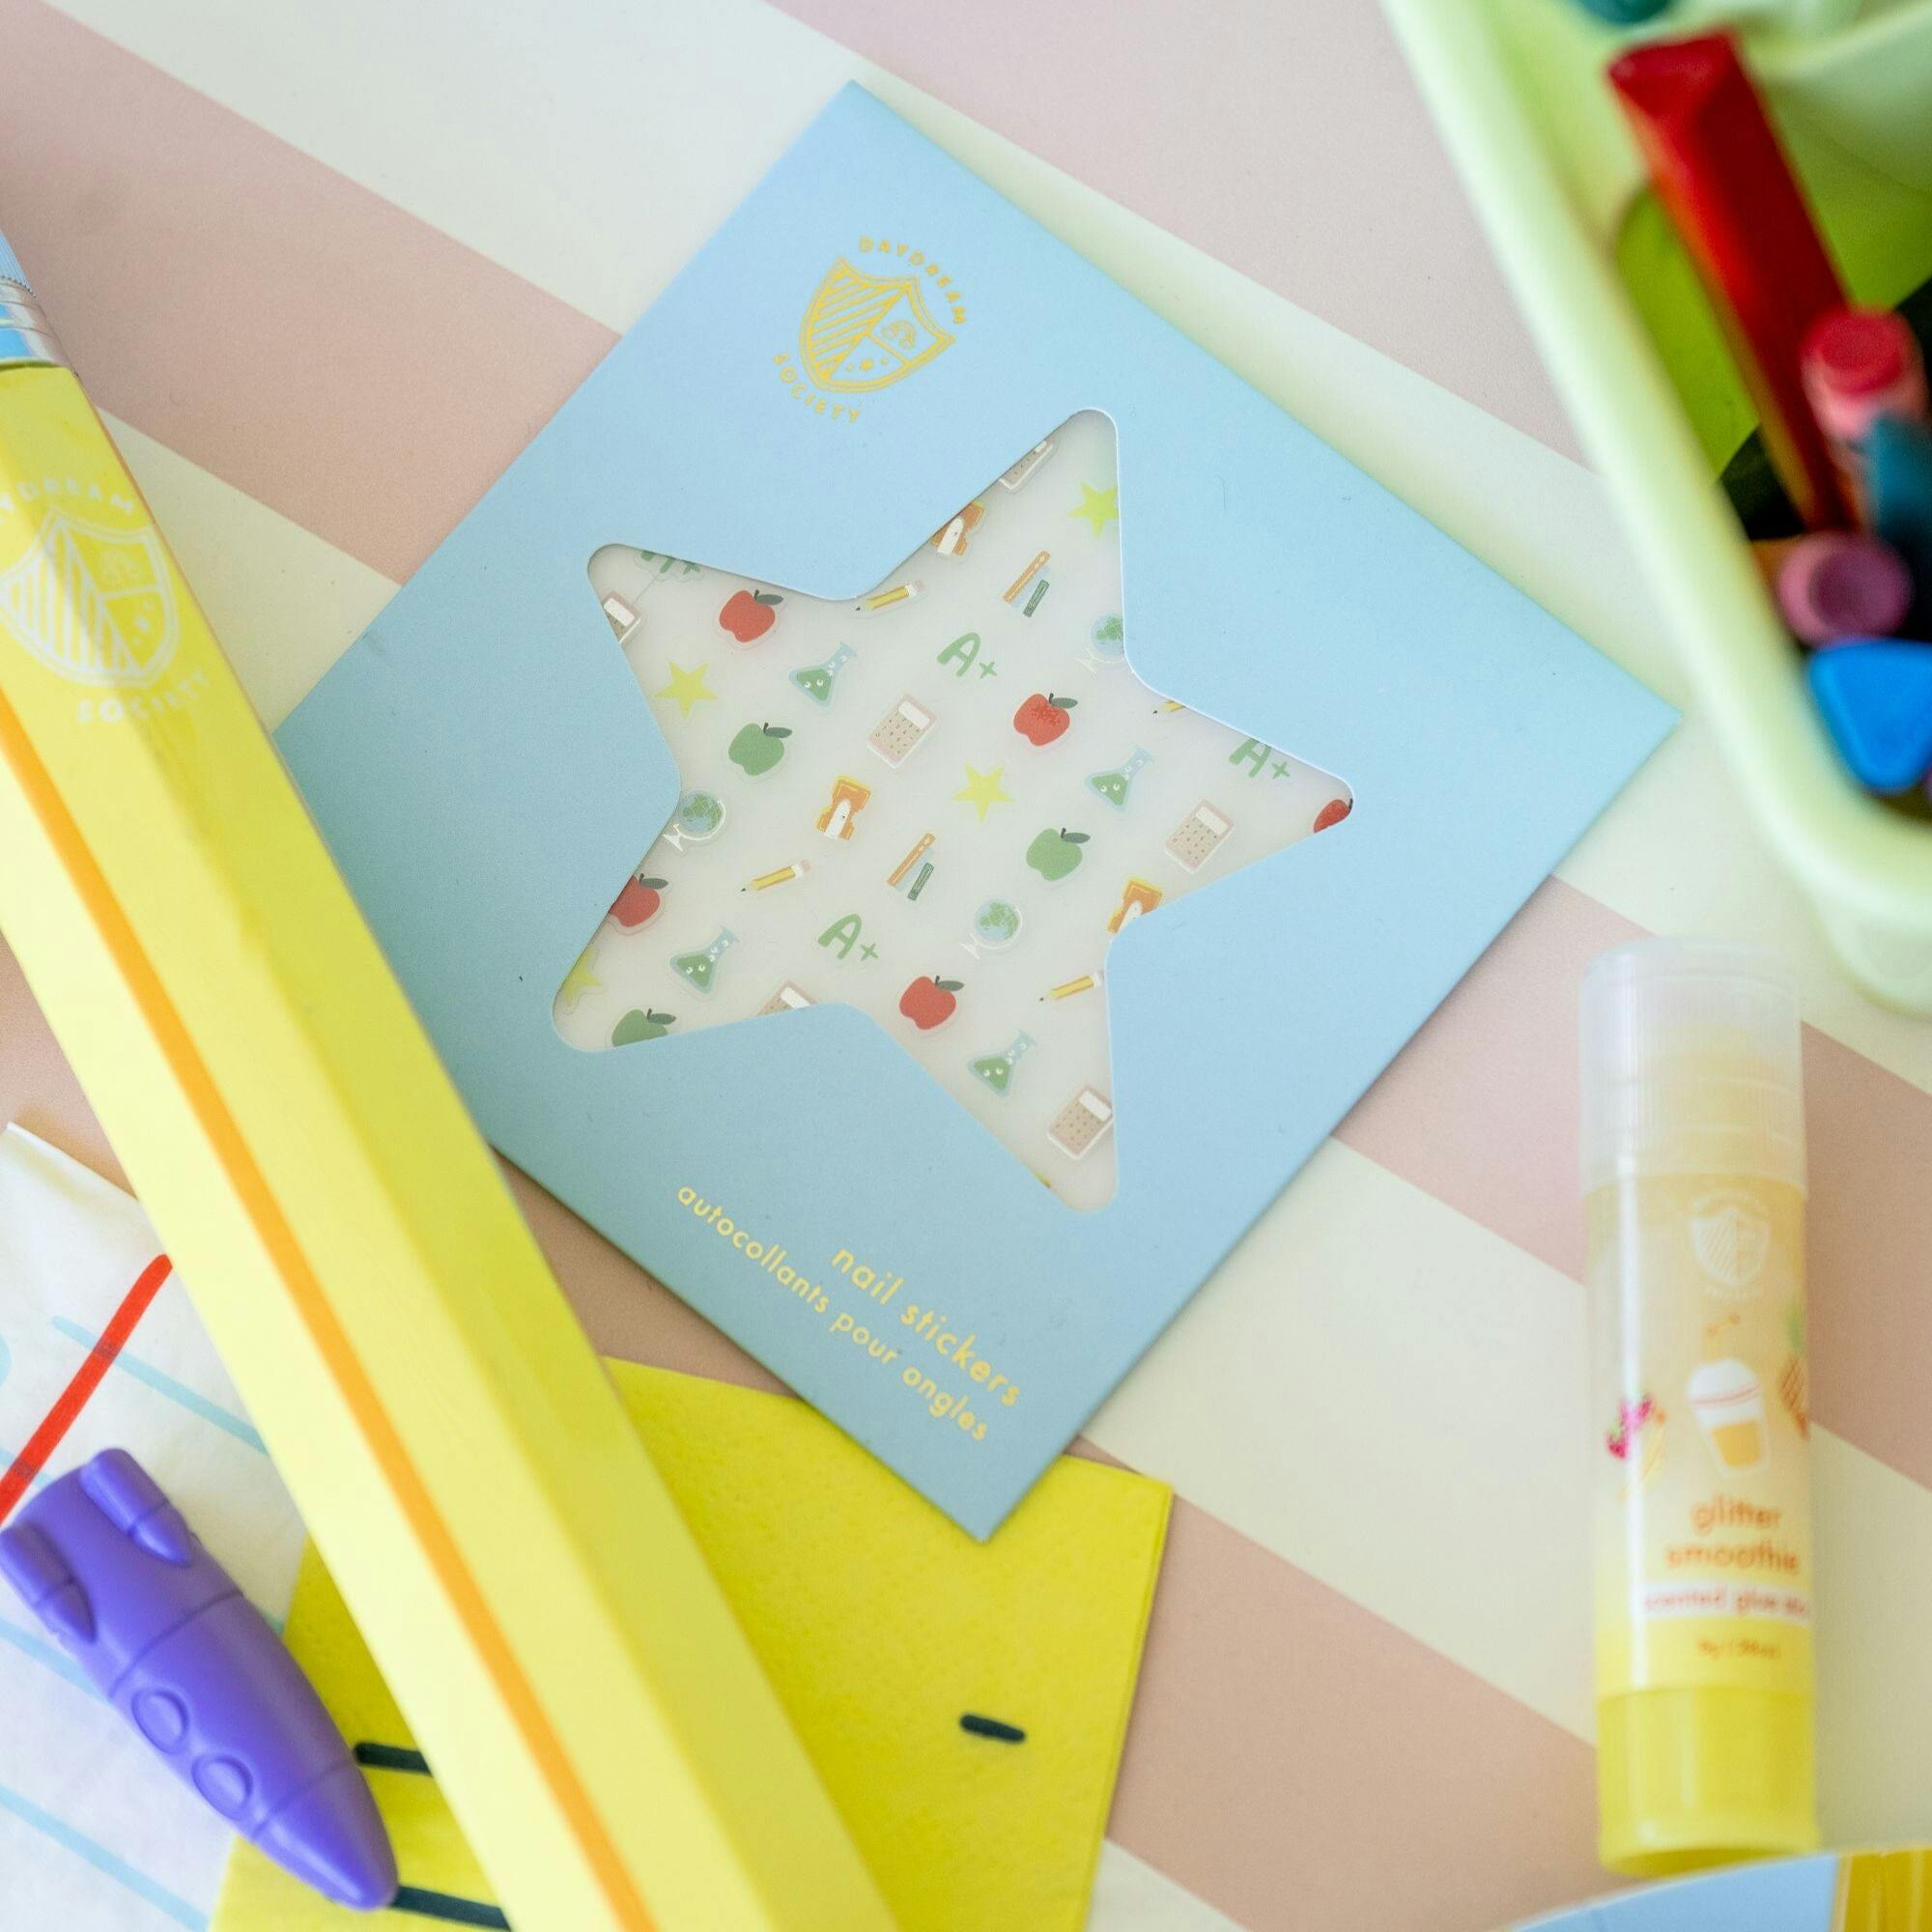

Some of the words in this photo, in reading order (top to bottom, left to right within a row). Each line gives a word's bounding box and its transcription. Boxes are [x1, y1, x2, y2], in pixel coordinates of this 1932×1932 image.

[858, 235, 966, 325] DAYDREAM
[773, 353, 862, 423] SOCIETY
[76, 668, 210, 724] SOCIETY
[677, 1186, 829, 1313] autocollants
[828, 1312, 898, 1364] pour
[901, 1366, 987, 1440] ongles
[831, 1248, 904, 1305] nail
[900, 1304, 1020, 1406] stickers
[1690, 1494, 1782, 1536] glitter
[1664, 1540, 1799, 1576] smoothie
